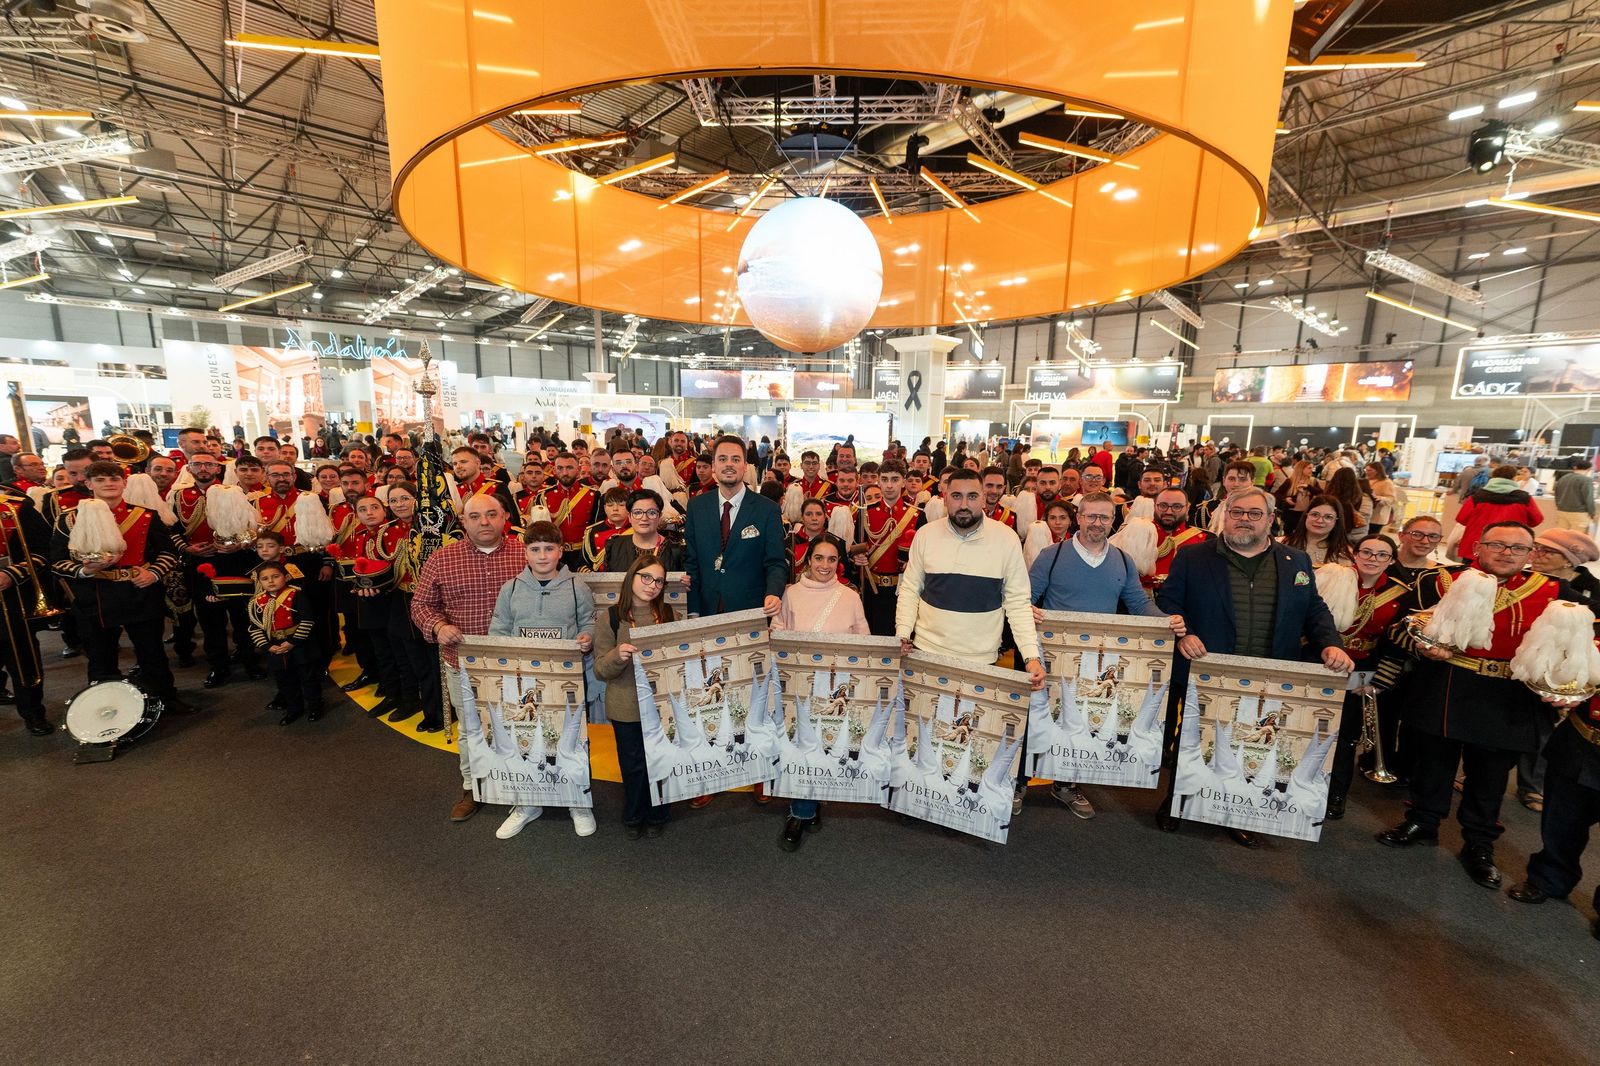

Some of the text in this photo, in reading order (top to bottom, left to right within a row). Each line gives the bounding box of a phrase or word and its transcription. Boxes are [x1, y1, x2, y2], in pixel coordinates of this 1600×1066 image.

[222, 372, 232, 399] AREA
[1458, 381, 1522, 396] CÁDIZ
[875, 390, 899, 400] JAÉN
[1028, 391, 1067, 401] HUELVA
[520, 628, 559, 638] NORWAY
[1050, 743, 1138, 764] ÚBEDA 2026
[672, 759, 722, 777] ÚBEDA
[726, 751, 758, 766] 2026
[787, 762, 869, 780] ÚBEDA 2026
[1062, 761, 1094, 769] SEMANA
[1095, 763, 1122, 771] SANTA
[489, 767, 569, 784] ÚBEDA 2026
[687, 773, 719, 784] SEMANA
[719, 767, 746, 777] SANTA
[904, 780, 950, 804] ÚBEDA
[955, 795, 987, 815] 2026
[1200, 786, 1298, 814] ÚBEDA 2026
[915, 798, 945, 811] SEMANA
[946, 807, 972, 819] SANTA
[1212, 804, 1247, 815] SEMANA
[1249, 810, 1279, 820] SANTA
